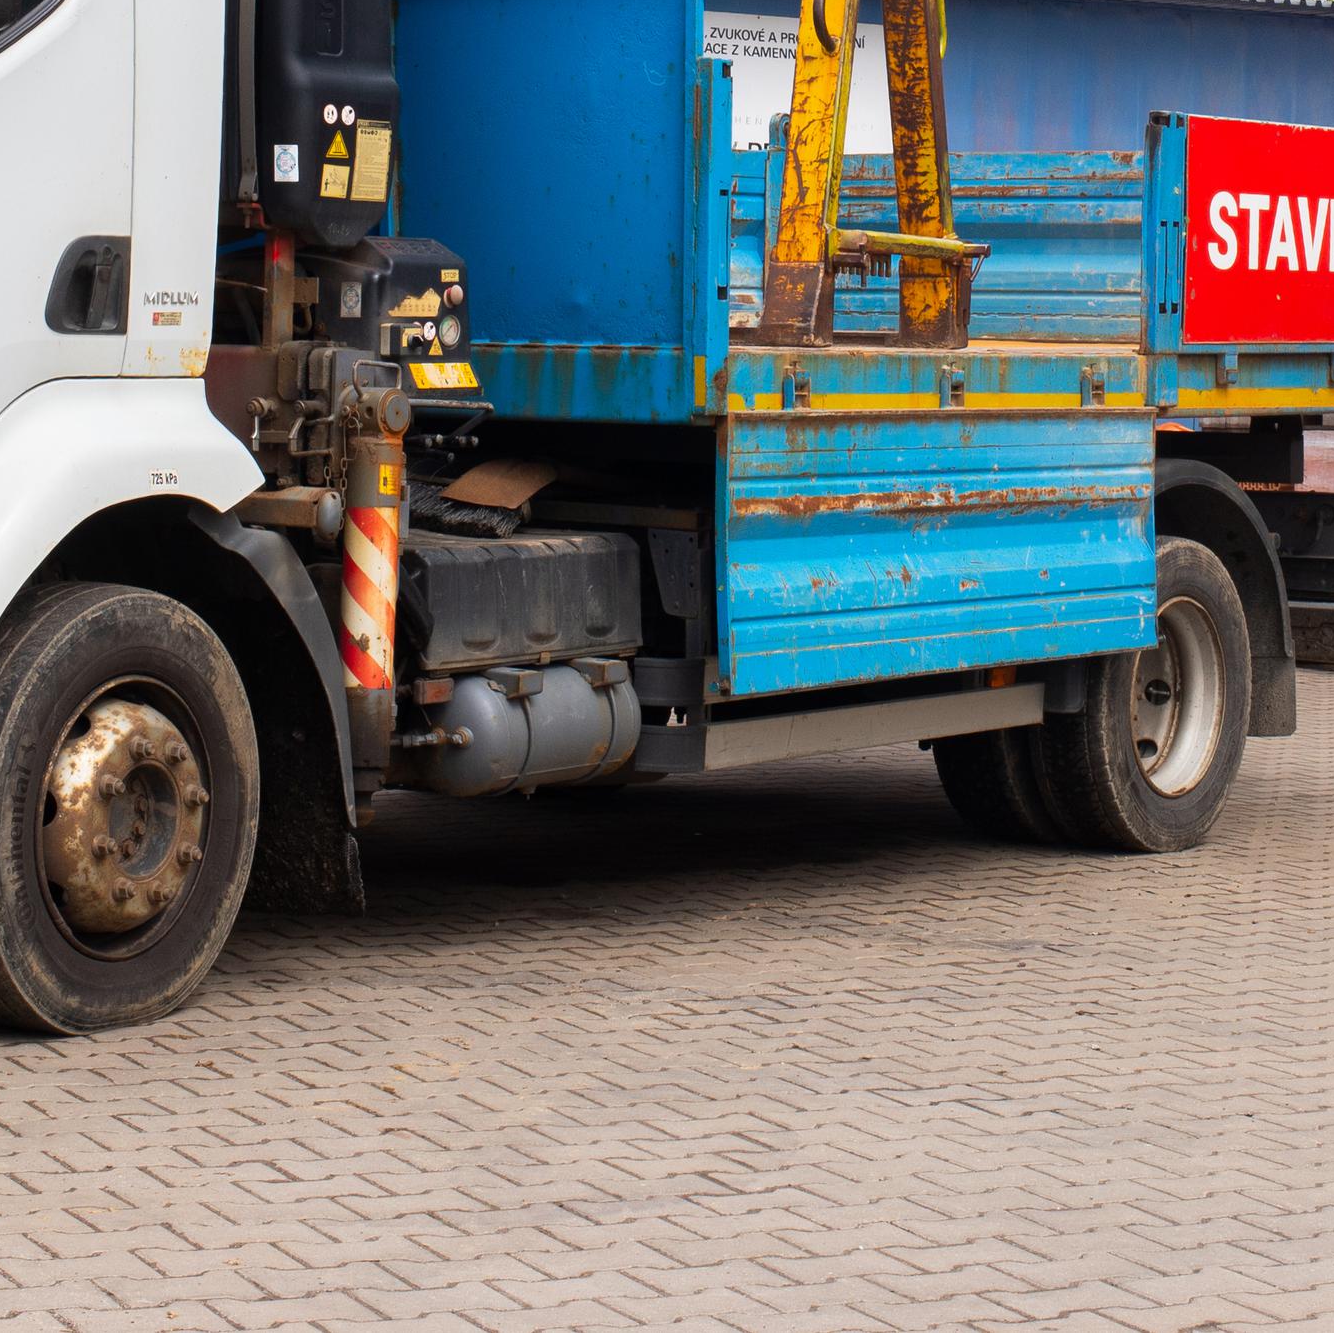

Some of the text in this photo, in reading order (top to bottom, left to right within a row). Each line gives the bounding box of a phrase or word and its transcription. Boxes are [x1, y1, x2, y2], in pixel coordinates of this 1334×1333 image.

[709, 26, 765, 43] ZVUKOVÉ
[768, 31, 778, 43] A
[731, 45, 739, 56] Z
[442, 271, 457, 281] STOP
[143, 291, 199, 306] MIDLUM
[164, 472, 178, 485] kPa
